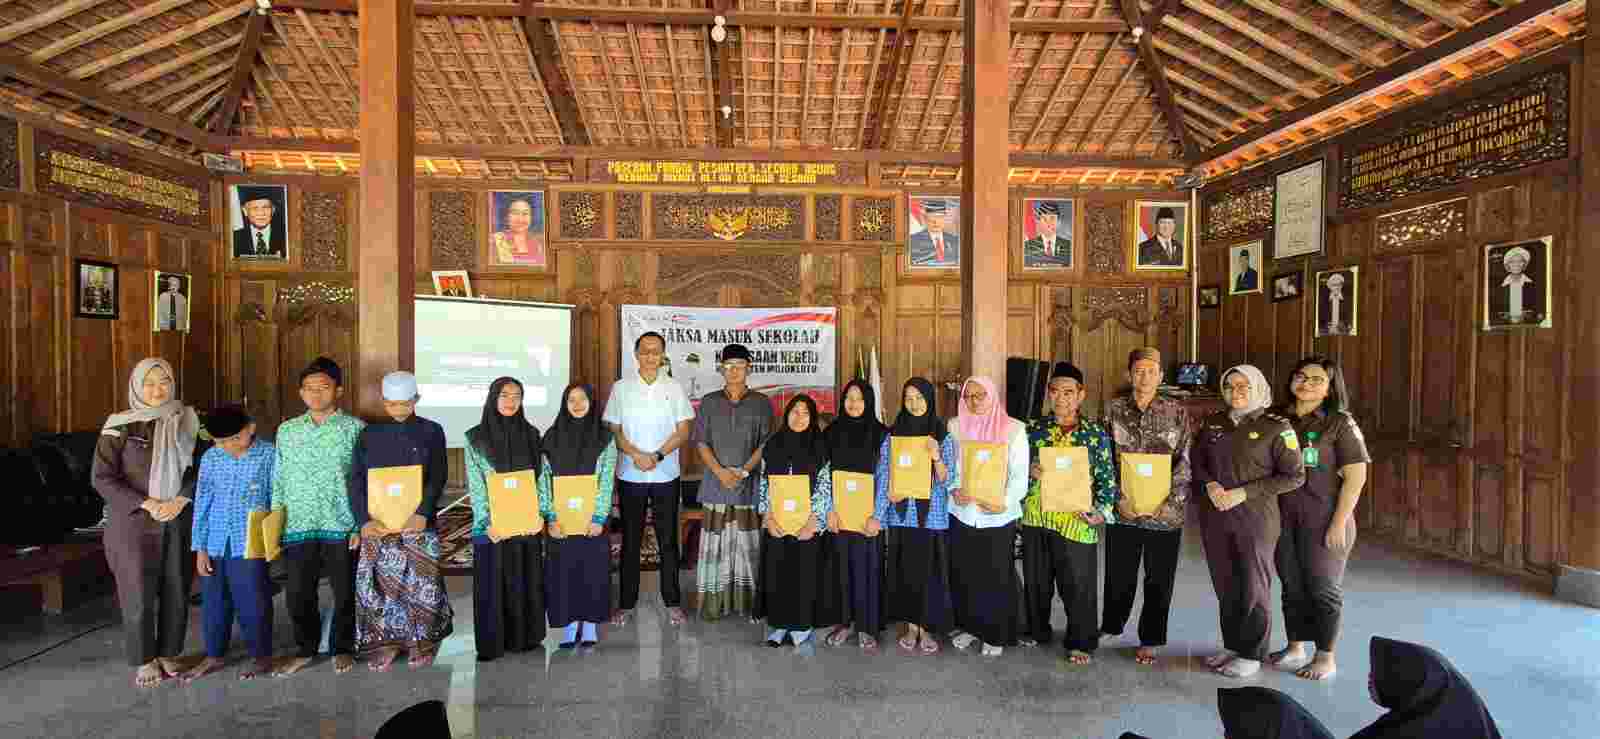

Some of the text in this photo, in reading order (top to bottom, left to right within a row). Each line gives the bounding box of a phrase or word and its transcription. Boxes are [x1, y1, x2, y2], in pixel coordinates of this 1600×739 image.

[707, 328, 752, 343] MASUK
[758, 329, 820, 344] SEKOLAH
[780, 350, 819, 364] NEGERI
